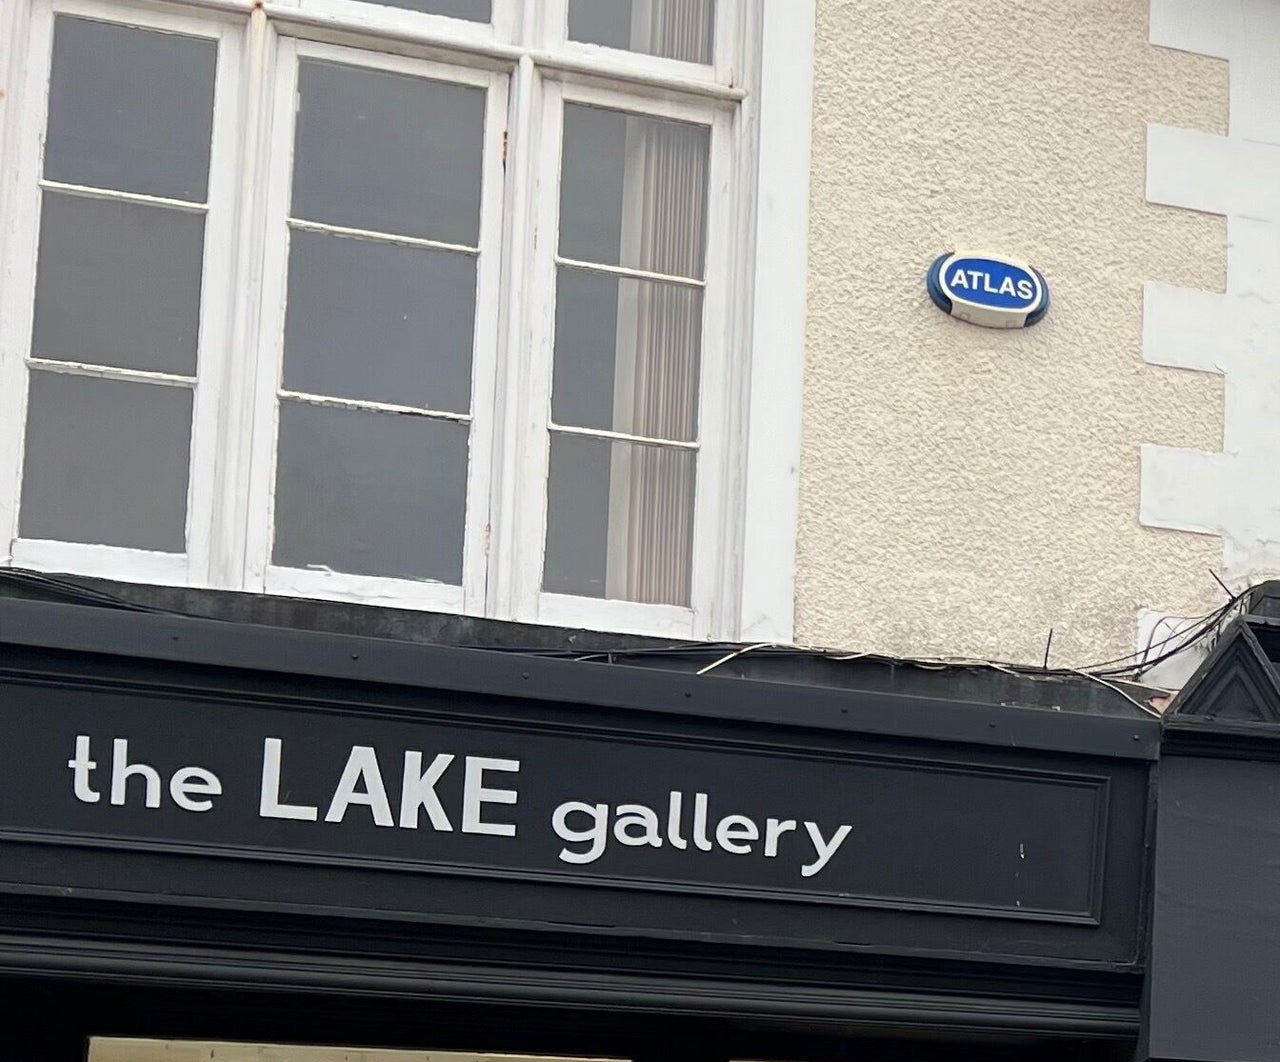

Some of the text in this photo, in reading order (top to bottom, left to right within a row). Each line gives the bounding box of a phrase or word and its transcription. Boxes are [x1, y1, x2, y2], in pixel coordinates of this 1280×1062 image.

[951, 269, 1033, 300] ATLAS
[68, 735, 853, 877] the LAKE gallery
